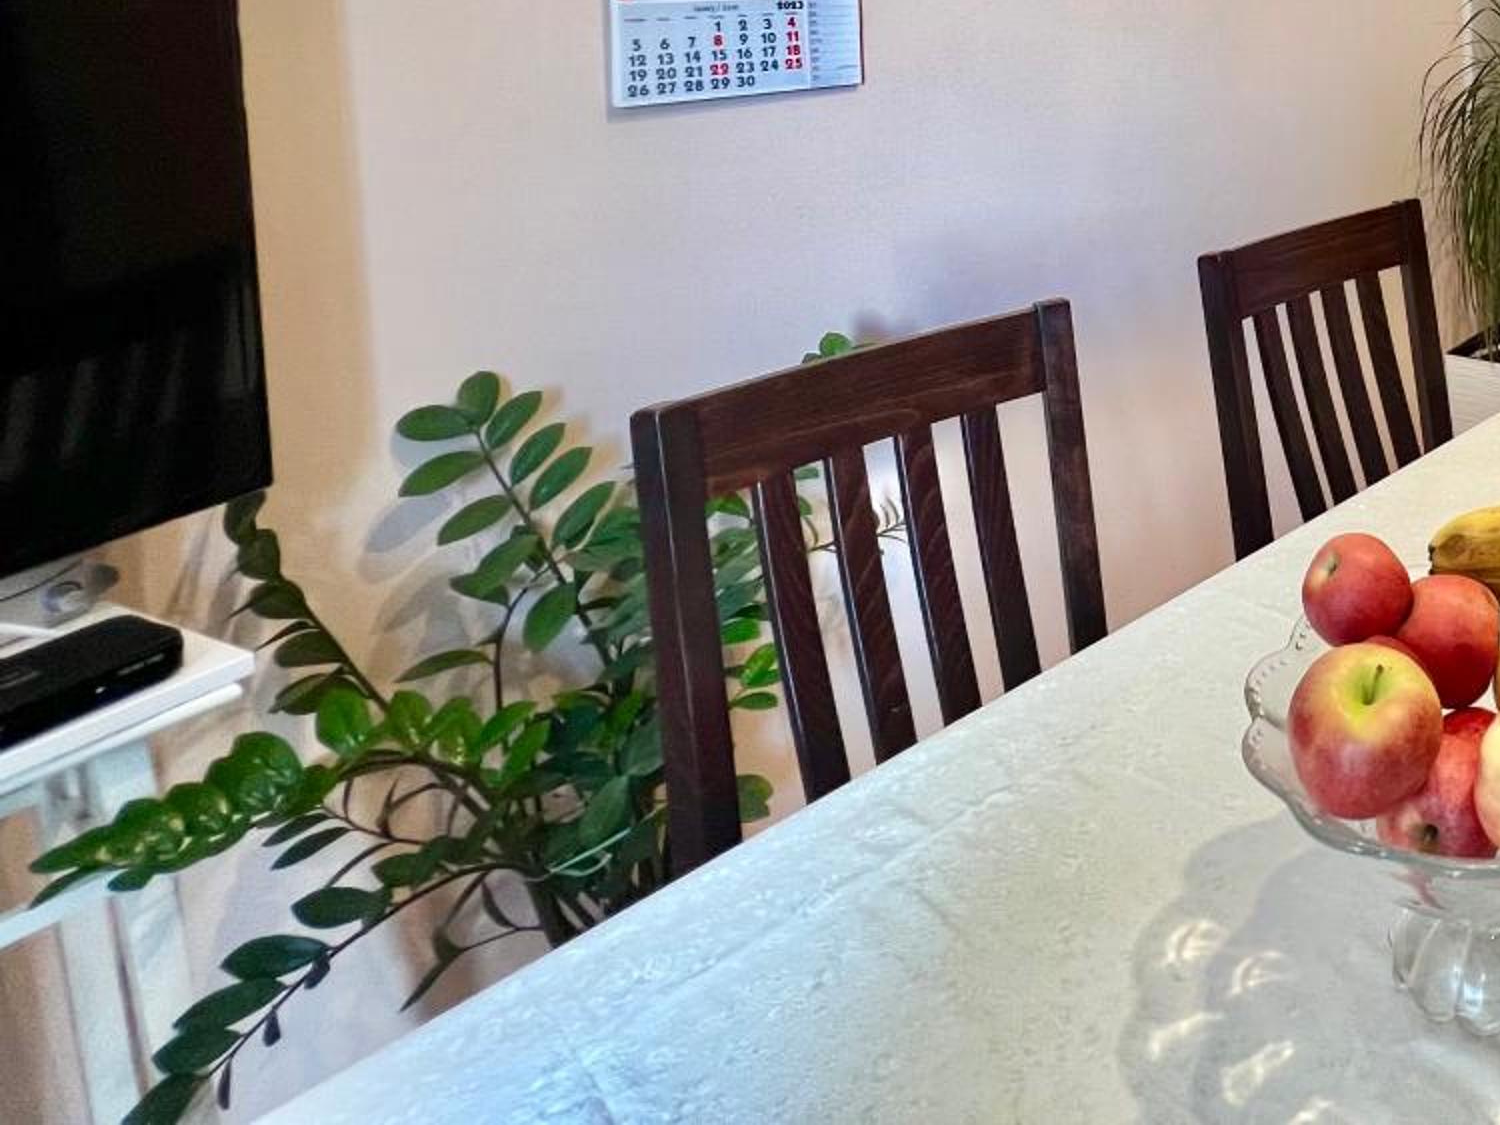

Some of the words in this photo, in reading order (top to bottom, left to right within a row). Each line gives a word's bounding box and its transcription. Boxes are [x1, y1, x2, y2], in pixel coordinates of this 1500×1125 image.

[714, 21, 721, 32] 1
[738, 20, 748, 31] 2
[764, 19, 772, 30] 3
[787, 17, 796, 27] 4
[632, 39, 641, 52] 5
[660, 38, 670, 50] 6
[688, 37, 696, 48] 7
[714, 35, 722, 46] 8
[739, 33, 748, 45] 9
[761, 33, 776, 43] 10
[786, 31, 799, 41] 11
[628, 55, 647, 67] 12
[658, 53, 674, 65] 13
[685, 51, 701, 63] 14
[712, 50, 727, 61] 15
[737, 48, 752, 59] 16
[762, 47, 776, 57] 17
[786, 45, 800, 56] 18
[629, 69, 647, 82] 19
[656, 67, 677, 80] 20
[685, 66, 703, 77] 21
[710, 63, 729, 76] 22
[736, 62, 755, 73] 23
[760, 59, 779, 71] 24
[784, 58, 803, 70] 25
[628, 85, 649, 98] 26
[657, 82, 676, 95] 27
[684, 80, 704, 92] 28
[710, 78, 730, 89] 29
[737, 76, 755, 87] 30
